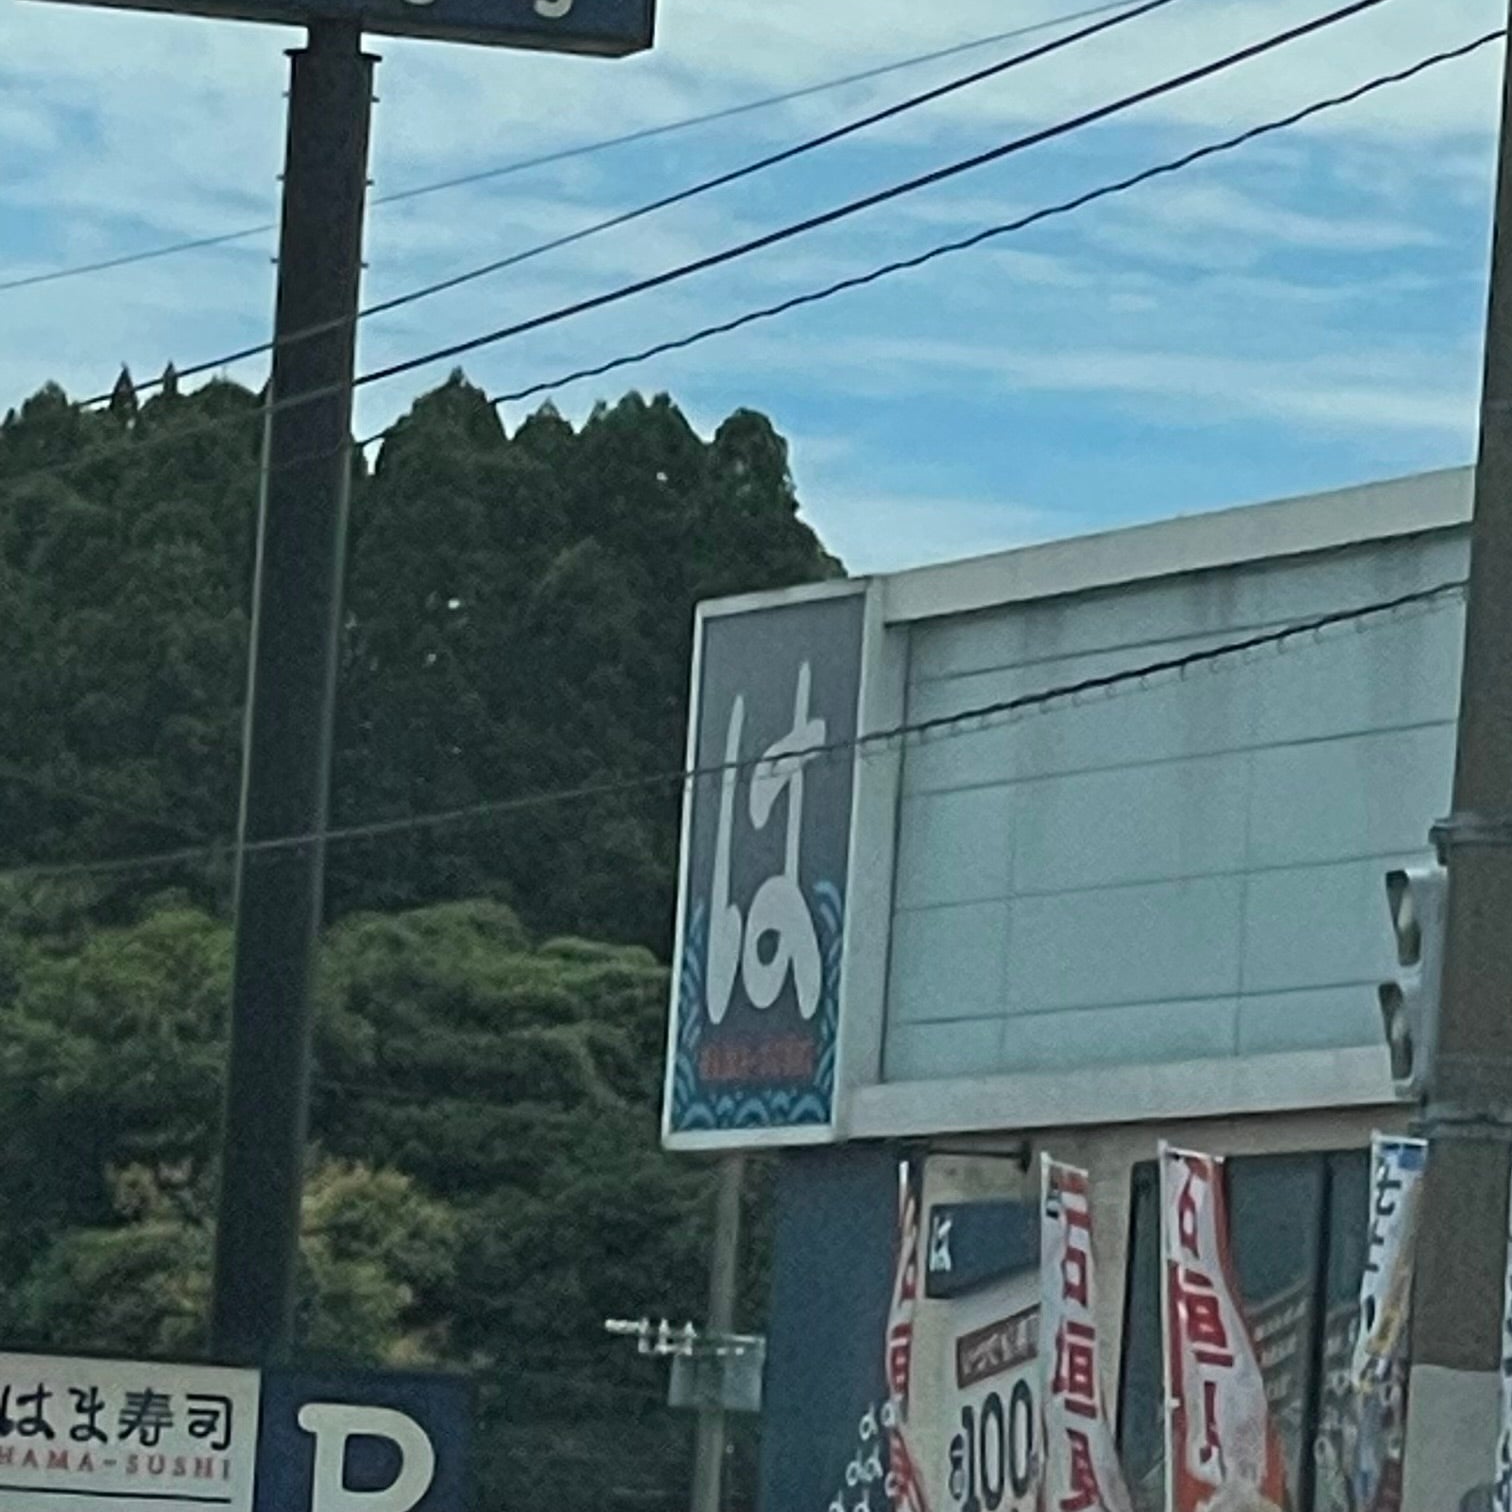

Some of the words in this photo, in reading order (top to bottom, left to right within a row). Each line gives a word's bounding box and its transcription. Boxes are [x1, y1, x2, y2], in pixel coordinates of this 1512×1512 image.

[705, 659, 826, 1025] は
[0, 1382, 233, 1450] はま寿司
